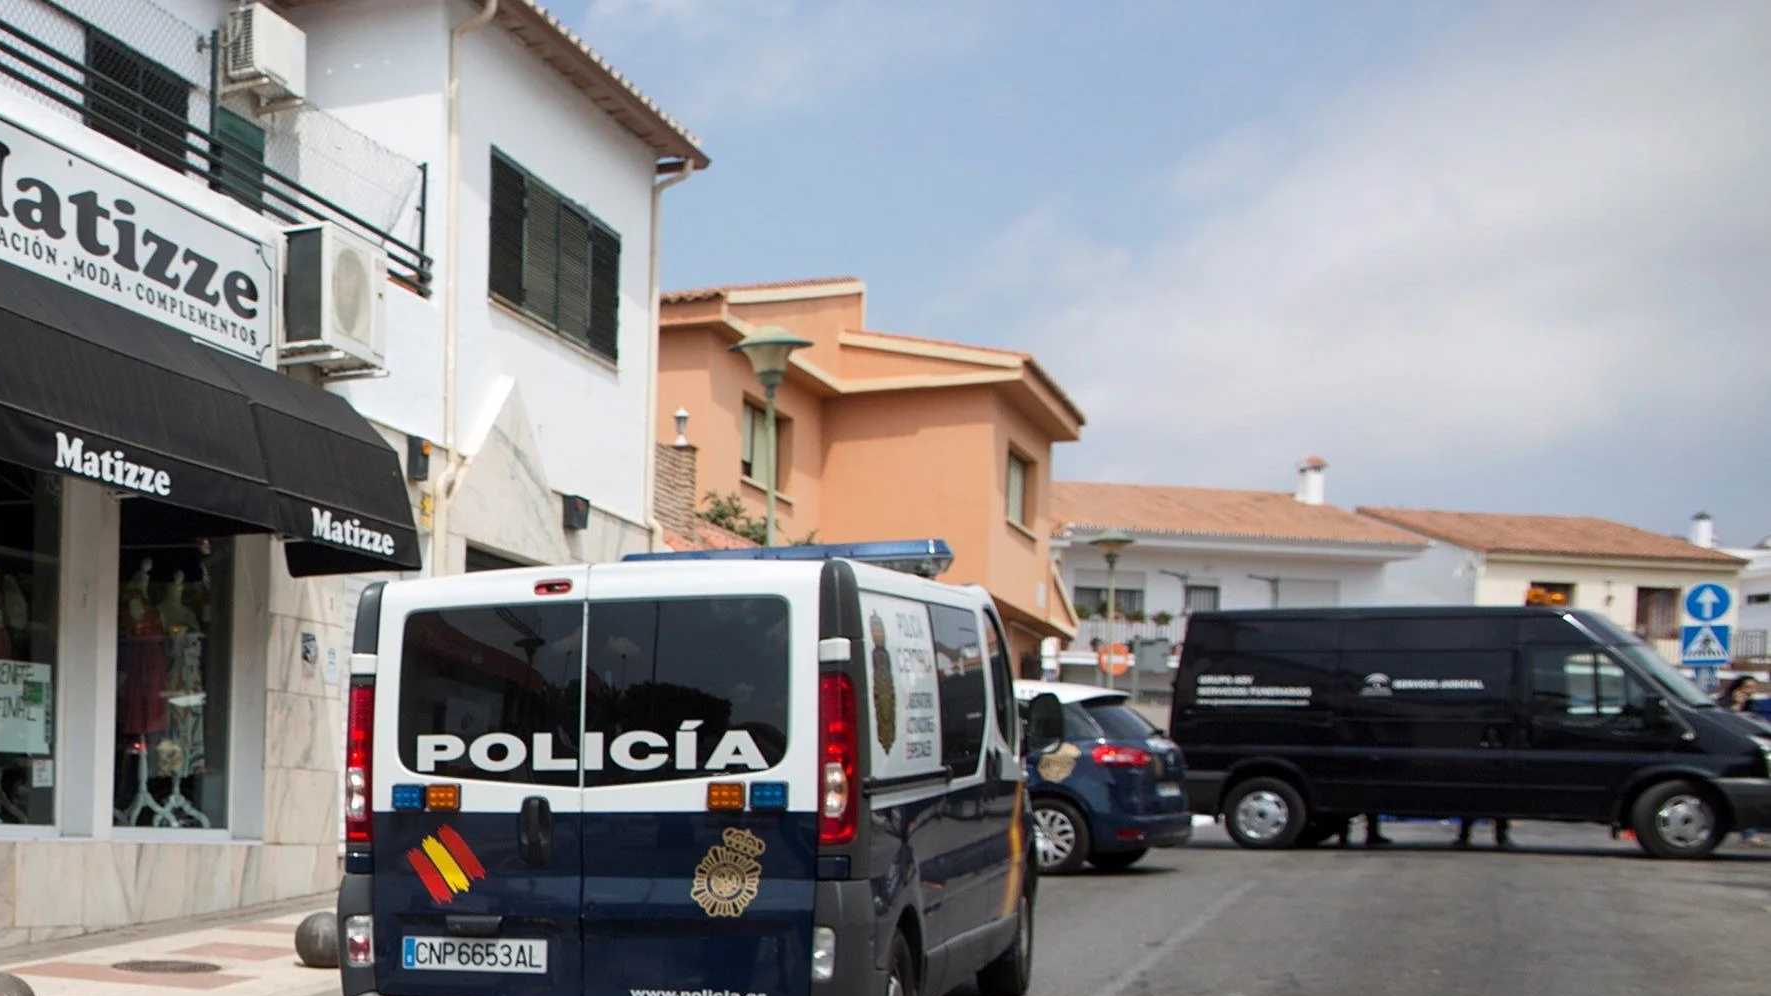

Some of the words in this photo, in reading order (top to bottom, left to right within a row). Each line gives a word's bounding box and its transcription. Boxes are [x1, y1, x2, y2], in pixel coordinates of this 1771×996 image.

[73, 256, 122, 292] MODA
[135, 283, 258, 347] COMPLEMENTOS
[55, 432, 171, 496] Matizze
[311, 507, 395, 556] Matizze
[417, 720, 769, 772] POLICÍA
